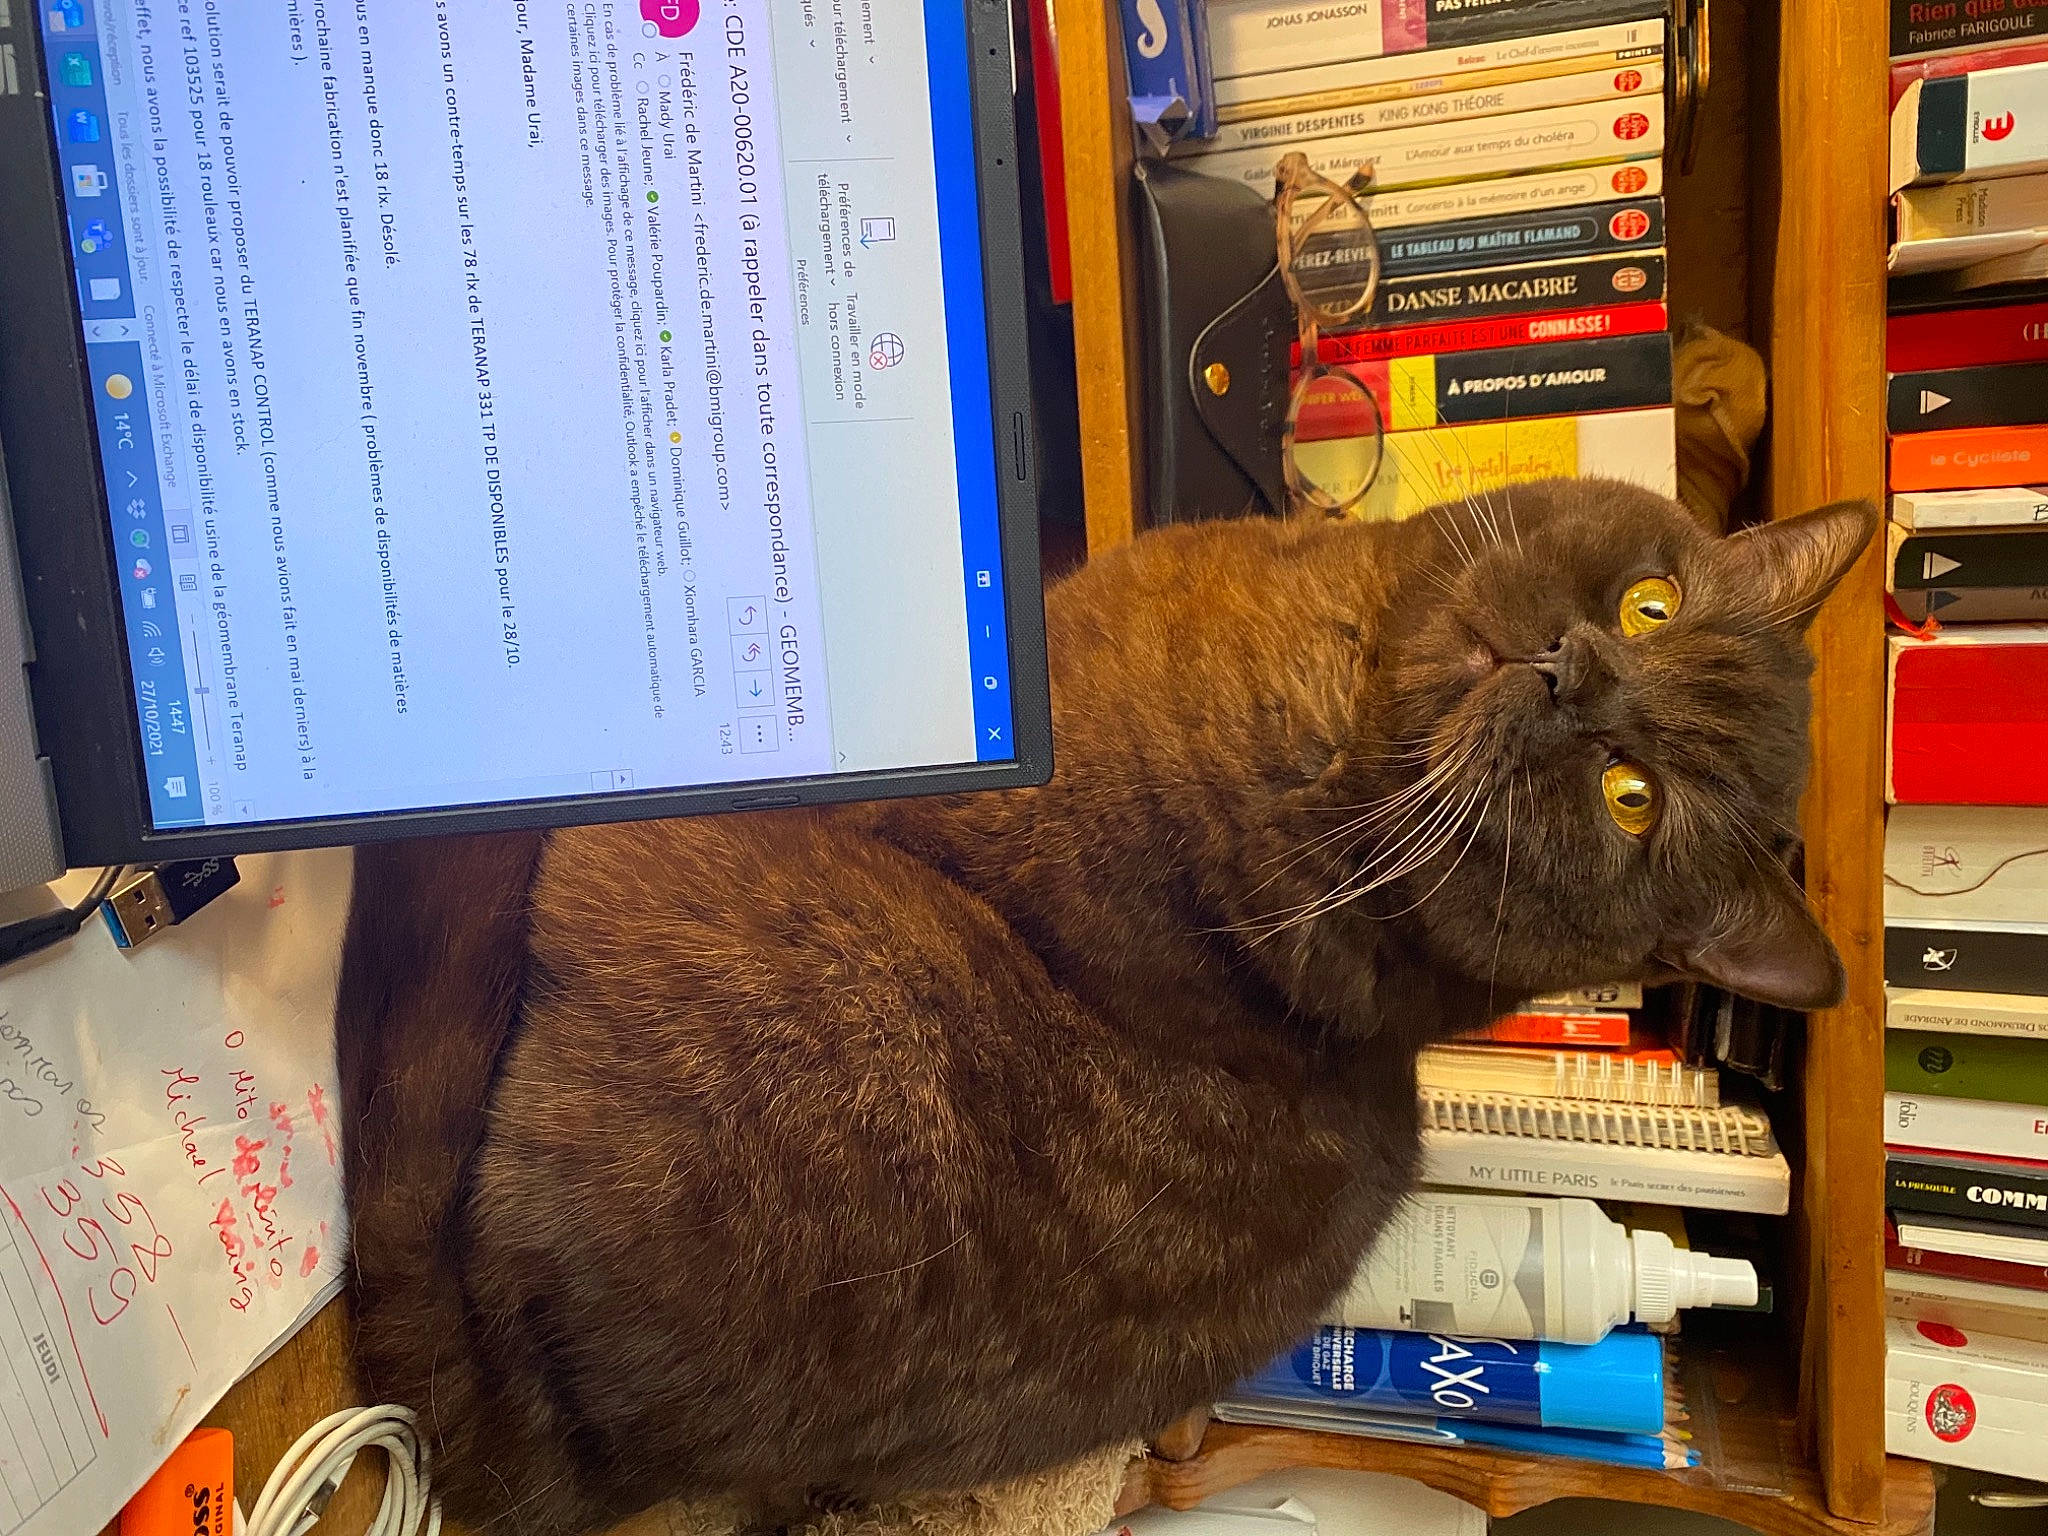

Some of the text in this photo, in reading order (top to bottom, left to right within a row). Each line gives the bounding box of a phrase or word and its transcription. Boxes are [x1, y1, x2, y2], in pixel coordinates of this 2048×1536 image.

[1267, 4, 1368, 29] JONAS JONASSON
[1909, 2, 1957, 24] Rien
[1909, 14, 2035, 45] Fabrice FARIGOULE
[520, 40, 543, 148] Madame Urai,
[834, 21, 852, 123] téléchargement
[567, 4, 593, 205] certaines images dans ce message.
[658, 92, 675, 159] Mady Urai
[1240, 113, 1366, 142] VIRGINIE DESPENTES
[1379, 92, 1504, 122] KING KONG THÉORIE
[359, 26, 401, 269] en manque donc 18 rlx. Désolé.
[637, 98, 654, 185] Rachel Jeune;
[1514, 135, 1530, 147] du
[180, 19, 250, 455] ref 103525 rouleaux stock.
[818, 173, 835, 277] téléchargement
[838, 184, 856, 277] Préférences de
[1391, 244, 1404, 259] LE
[1405, 238, 1455, 256] TABLEAU
[1524, 225, 1581, 243] FLAMAND
[648, 206, 669, 325] Valérie Poupardin;
[678, 53, 736, 512] Frédéric de Martini <frederic.de.martini@bmigroup.com>
[794, 260, 809, 325] Préférences
[1387, 286, 1463, 314] DANSE
[1467, 274, 1579, 305] MACABRE
[437, 14, 520, 668] avons un contre-temps sur les 78 rlx de TERANAP 331 TP DE DISPONIBLES pour le 28/10.
[829, 303, 844, 400] hors connexion
[847, 292, 867, 409] Travailler en mode
[1406, 329, 1471, 350] PARFAITE
[660, 347, 678, 426] Karla Pradet;
[726, 15, 804, 742] CDE A20-00620.01 (à rappeler dans toute correspondance) GEOMEMB...
[1463, 374, 1527, 394] PROPOS
[1529, 368, 1608, 388] D'AMOUR
[670, 448, 692, 565] Dominique Guillot;
[684, 585, 705, 697] Xiomhara GARCIA
[139, 680, 164, 758] 27/10/2021
[167, 699, 186, 735] 14:47
[720, 723, 733, 754] 12:43
[1903, 1013, 1952, 1028] ANDRADE
[1954, 1017, 1968, 1028] DE
[1969, 1018, 2036, 1034] DRUMMOND
[160, 1067, 226, 1185] Michael
[1898, 1099, 1919, 1129] folio
[1469, 1164, 1599, 1190] MY LITTLE PARIS
[1445, 1205, 1457, 1261] NETTOYANT
[1433, 1240, 1445, 1293] FRAGILES
[30, 1332, 62, 1385] JEUDI
[1321, 1350, 1331, 1371] GAZ
[1906, 1379, 1921, 1434] BOUQUINS
